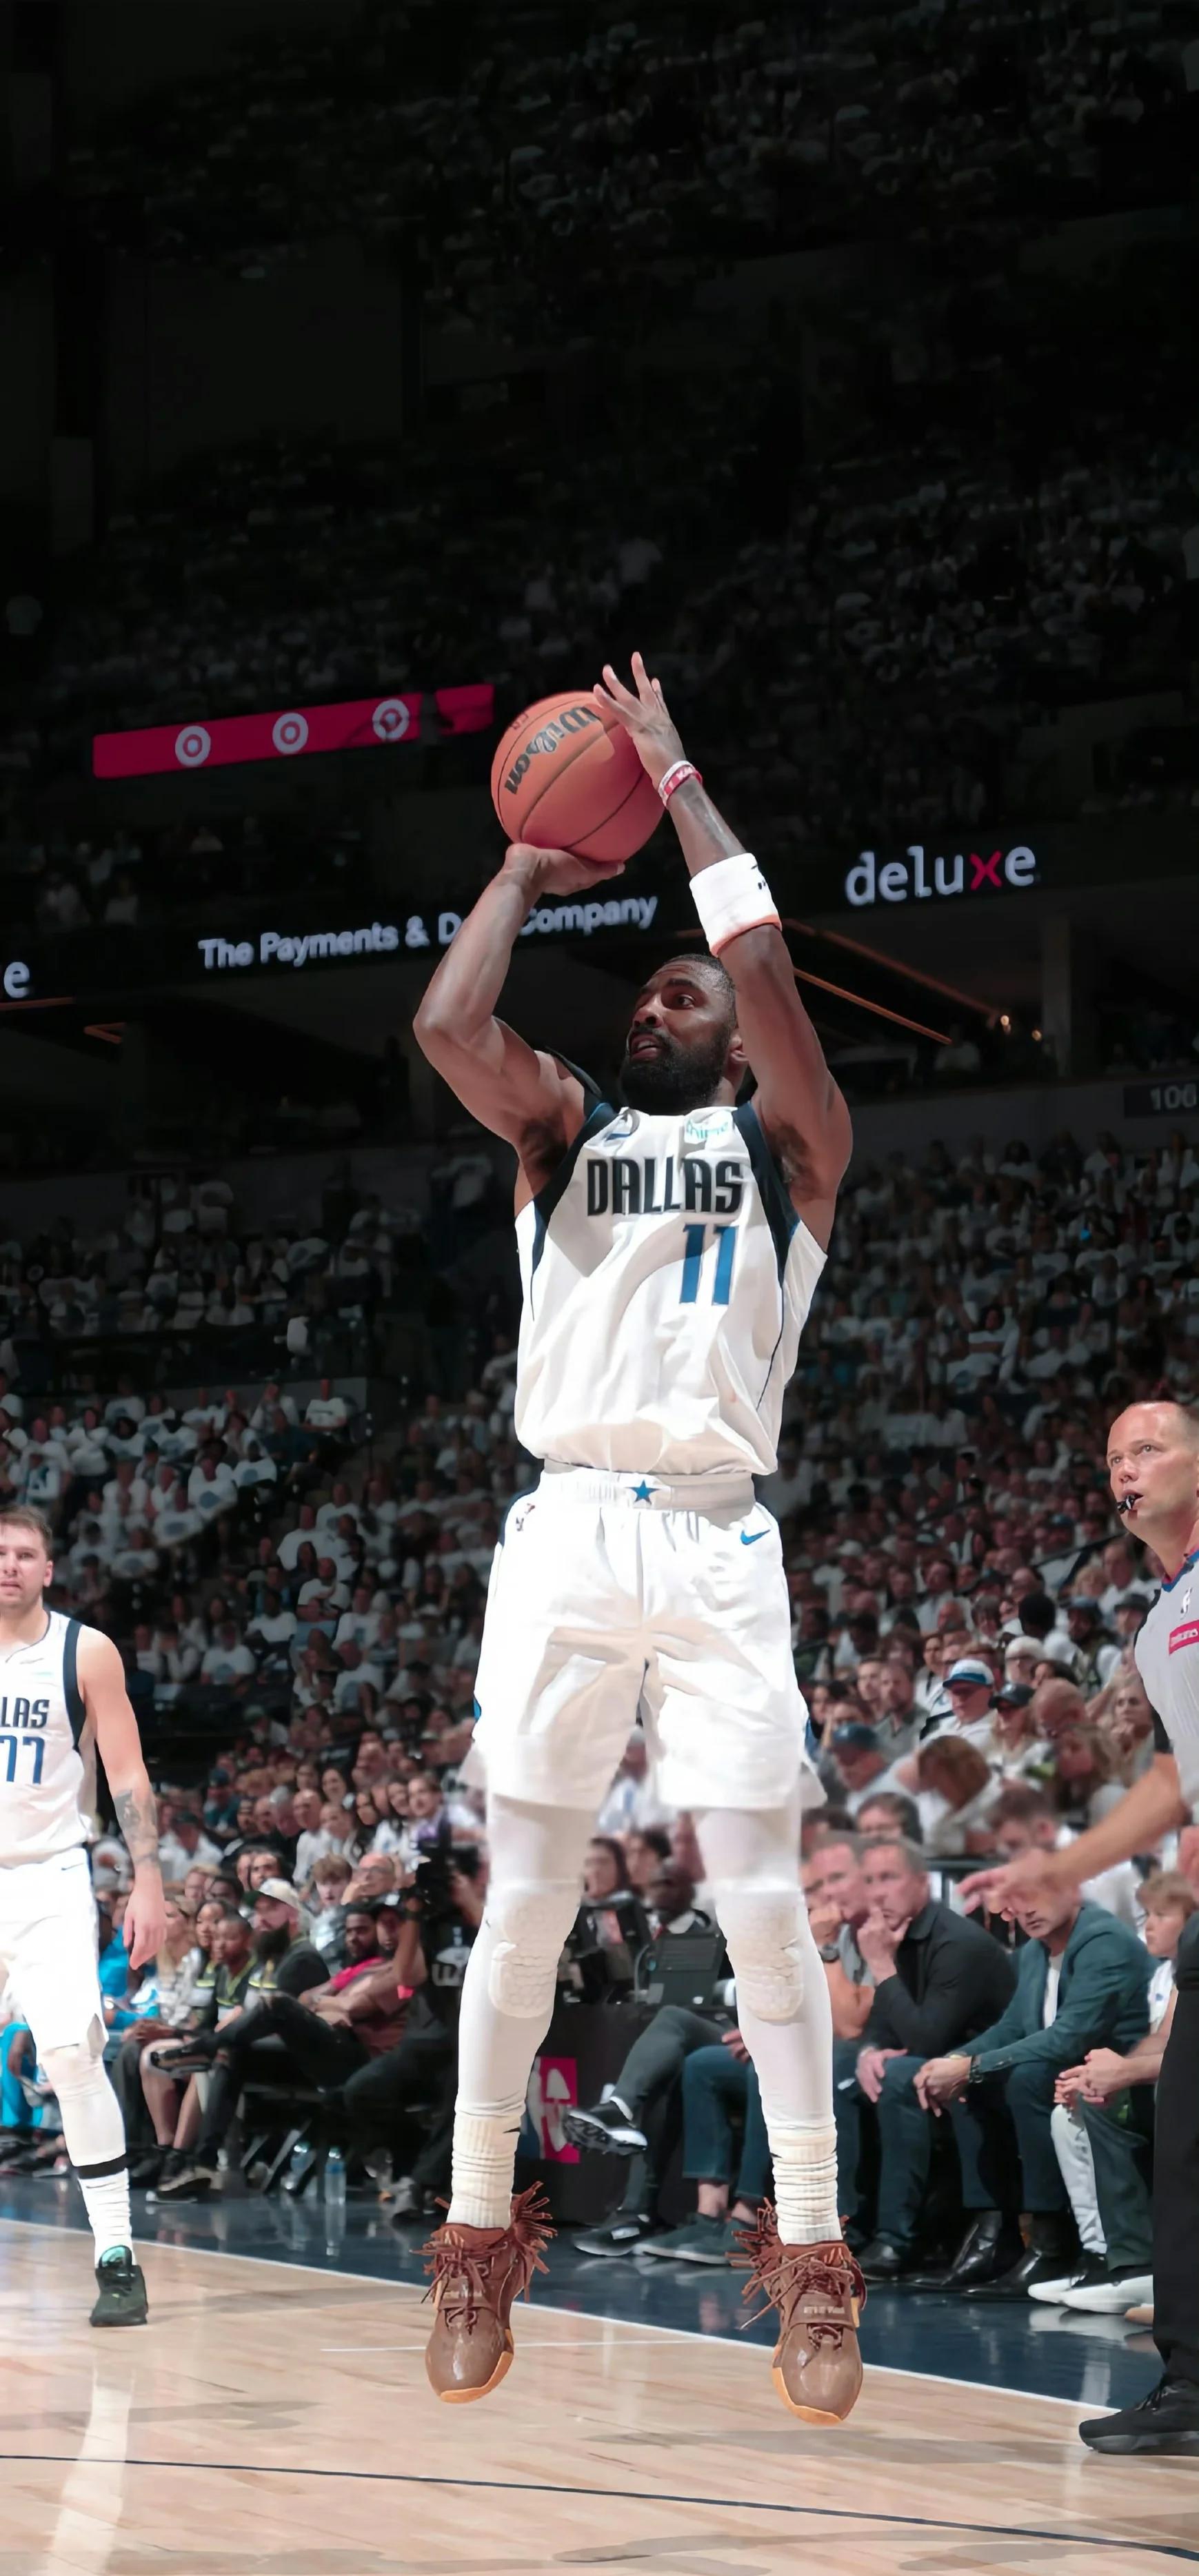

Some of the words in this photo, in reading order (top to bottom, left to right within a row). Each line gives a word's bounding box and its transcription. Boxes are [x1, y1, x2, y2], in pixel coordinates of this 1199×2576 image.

[504, 707, 602, 795] Wilson
[845, 845, 1036, 906] deluxe
[198, 937, 254, 969] The
[260, 922, 399, 968] Payments
[405, 915, 430, 949] &
[587, 1156, 745, 1217] DALLAS
[678, 1223, 740, 1306] 11
[0, 1734, 46, 1785] 77
